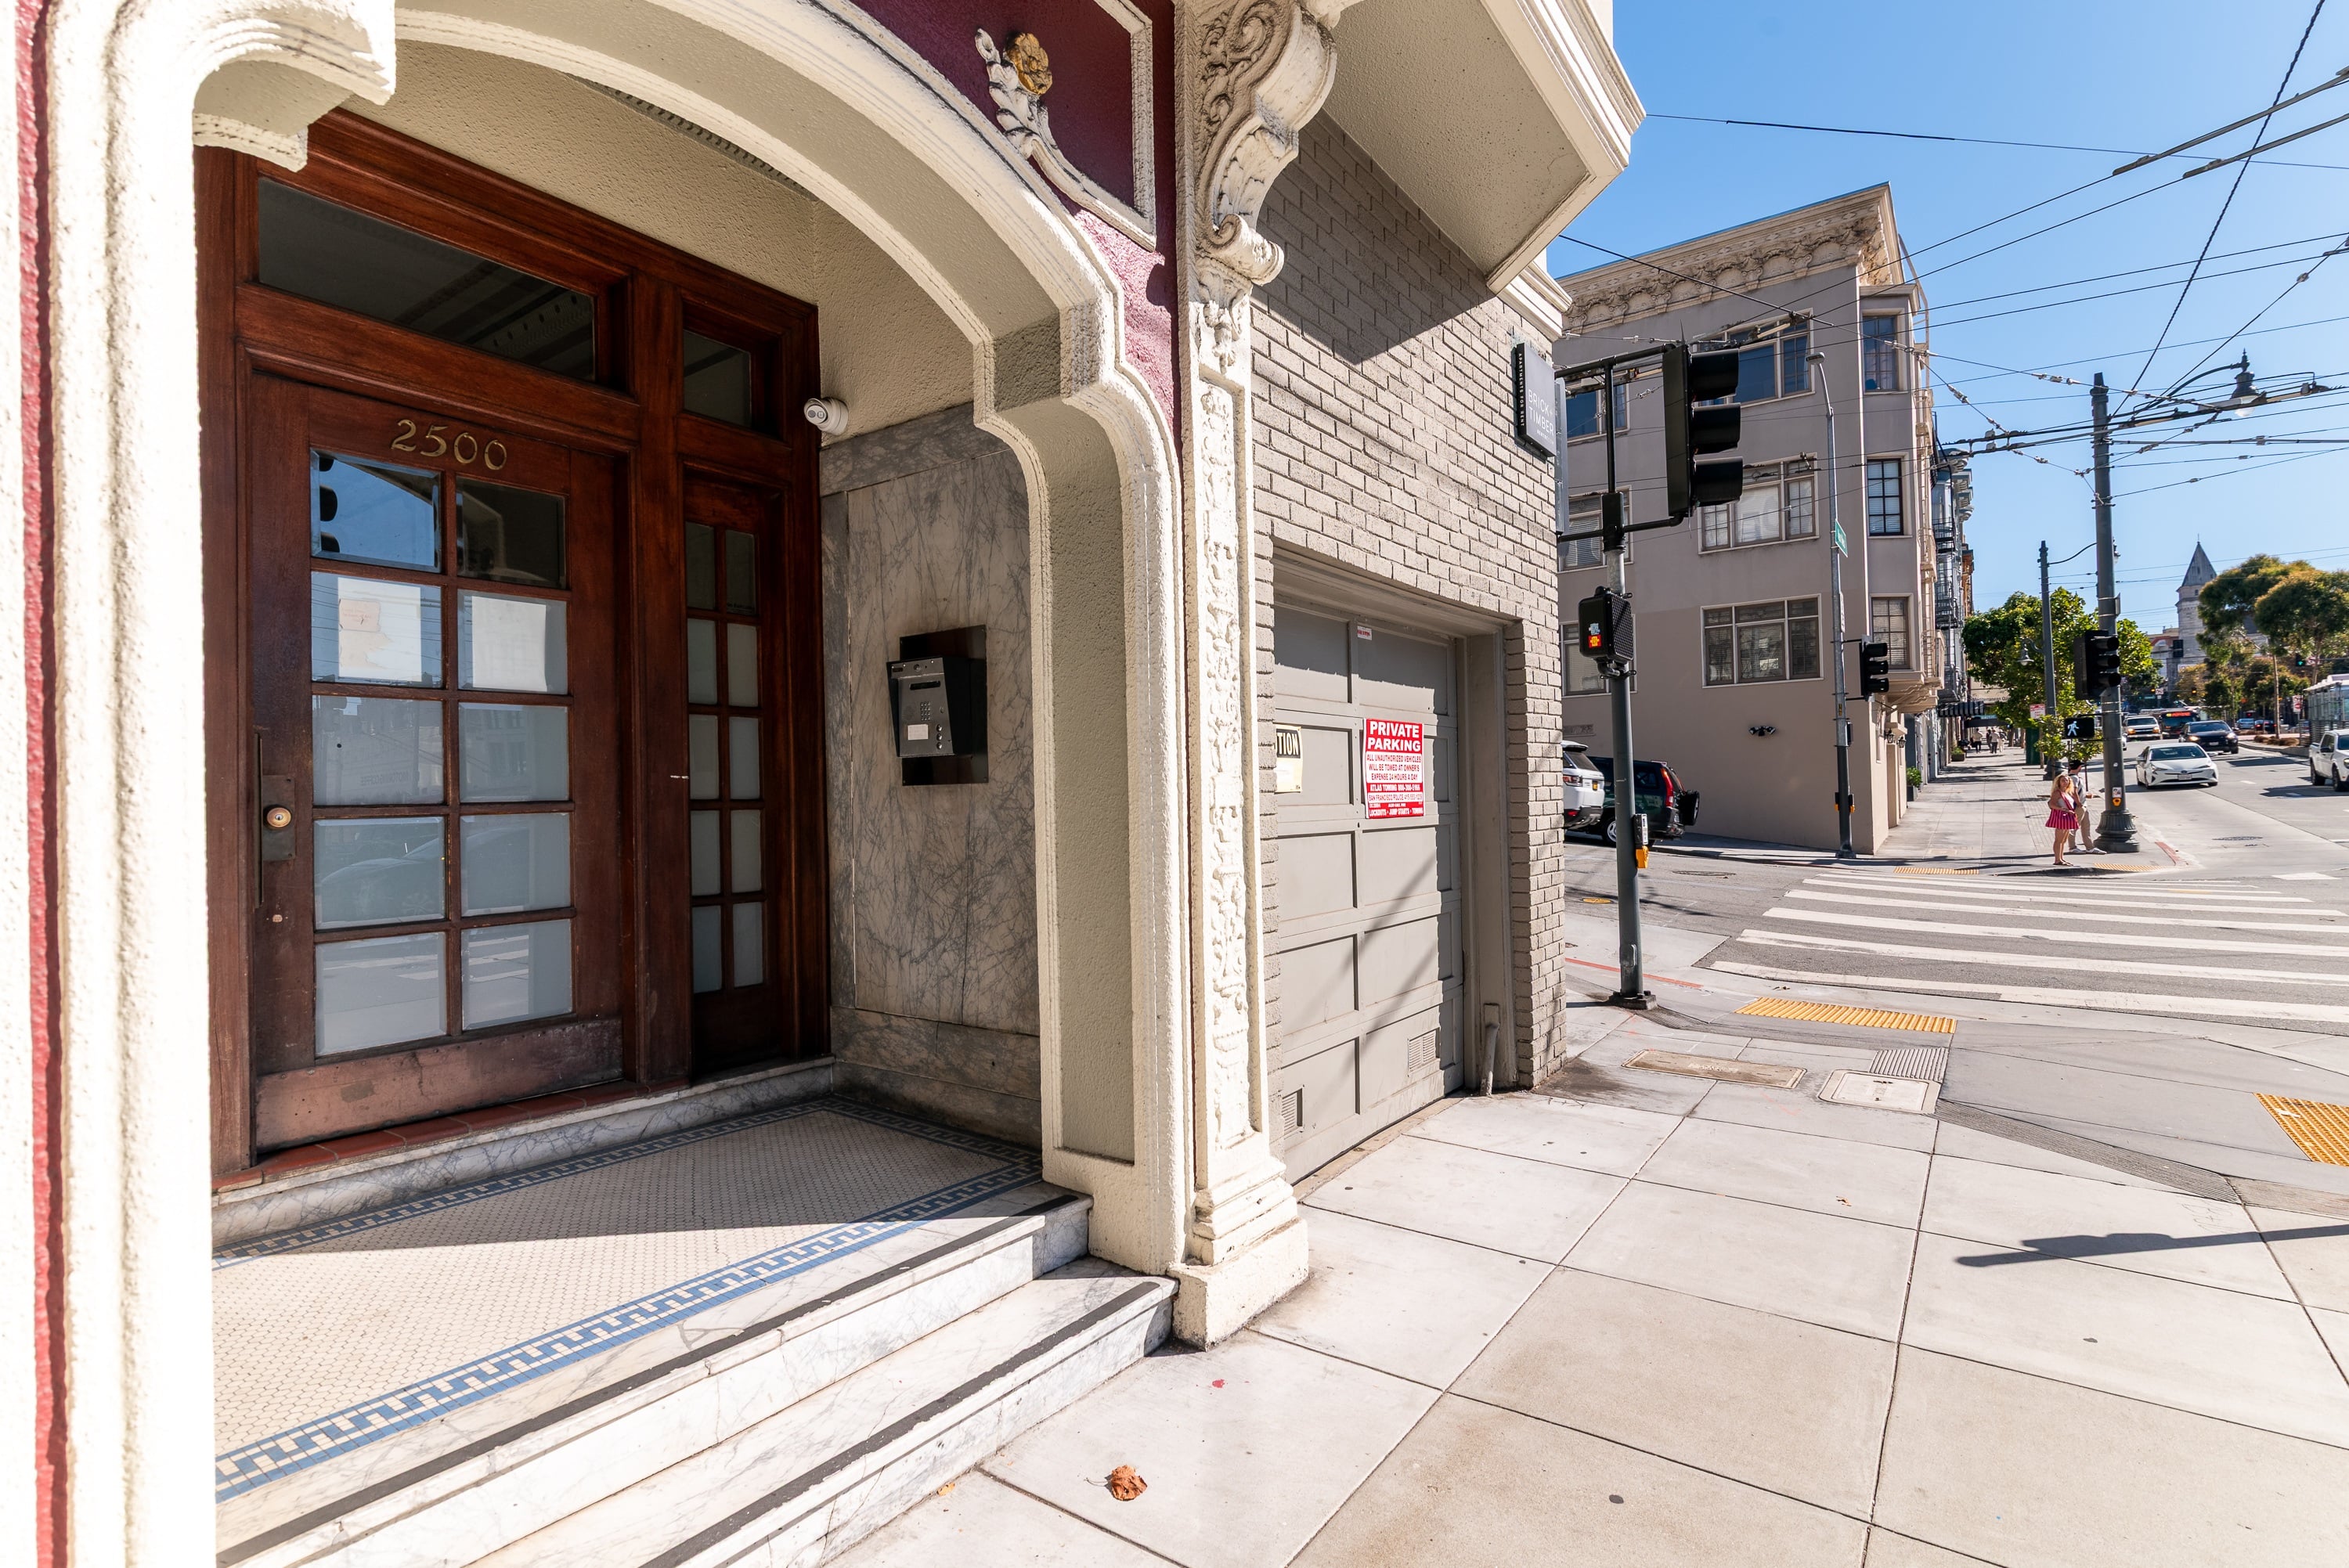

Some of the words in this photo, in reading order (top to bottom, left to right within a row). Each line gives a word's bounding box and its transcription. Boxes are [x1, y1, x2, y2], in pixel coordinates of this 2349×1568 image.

[1528, 388, 1550, 417] BRICK
[1528, 406, 1554, 437] TIMBER
[391, 419, 507, 470] 2500
[1369, 720, 1420, 738] PRIVATE
[1367, 737, 1421, 752] PARKING
[1375, 754, 1404, 762] UNAUTHORIZED
